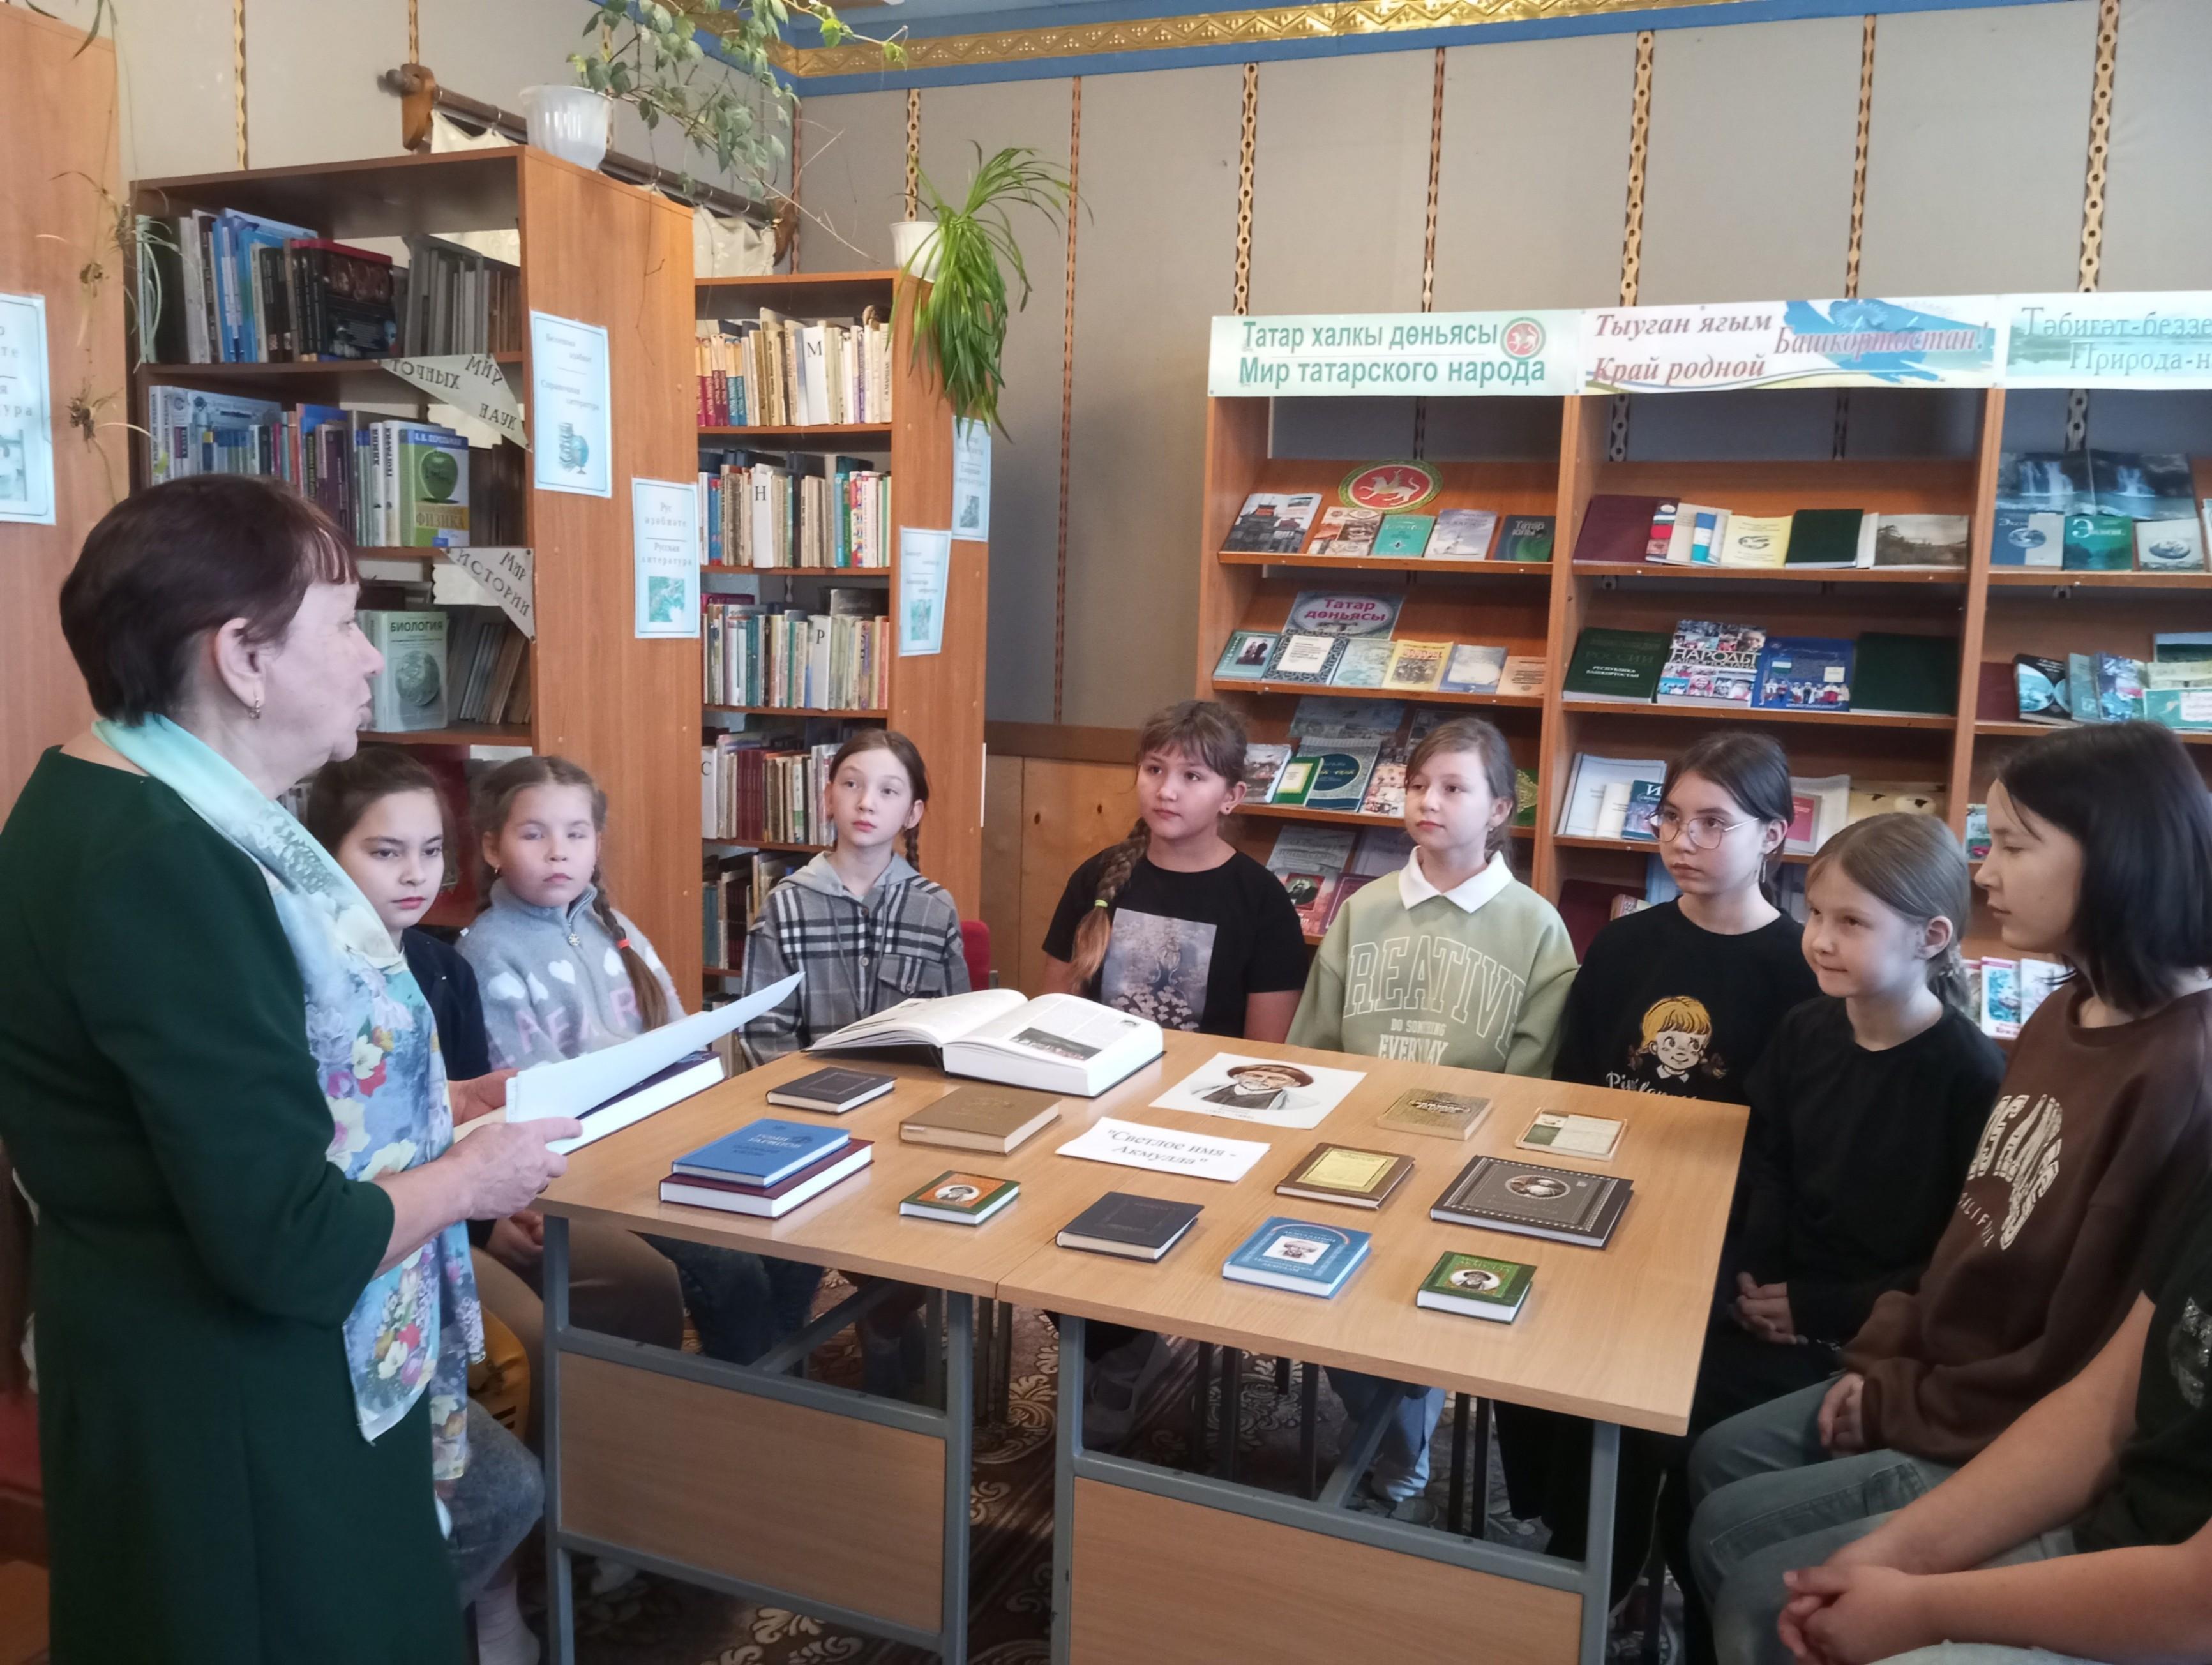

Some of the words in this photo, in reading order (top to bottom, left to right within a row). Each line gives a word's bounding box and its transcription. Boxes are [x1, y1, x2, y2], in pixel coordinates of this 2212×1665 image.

[806, 340, 823, 358] М
[1243, 321, 1304, 354] Татар
[1311, 326, 1383, 347] халкы
[1388, 324, 1497, 350] дөньясы
[1773, 321, 1989, 361] Башкортостан!
[390, 359, 460, 389] ТОЧНЫХ
[465, 356, 504, 386] МИР
[1239, 357, 1290, 389] Мир
[1298, 361, 1438, 389] татарского
[1448, 360, 1545, 389] народа
[1593, 356, 1660, 386] Край
[1666, 353, 1766, 386] родной
[479, 403, 518, 431] НАУК
[755, 485, 767, 501] Н
[416, 513, 464, 527] ФИЗИКА
[456, 549, 531, 617] ИСТОРИИ
[1304, 610, 1386, 621] дөньясы
[1323, 598, 1376, 612] Татар
[390, 621, 443, 633] БИОЛОГИЯ
[1669, 646, 1761, 665] НАРОДЫ
[1390, 1018, 1403, 1032] DO
[1108, 1129, 1185, 1150] "Светлое
[1189, 1145, 1227, 1157] имя
